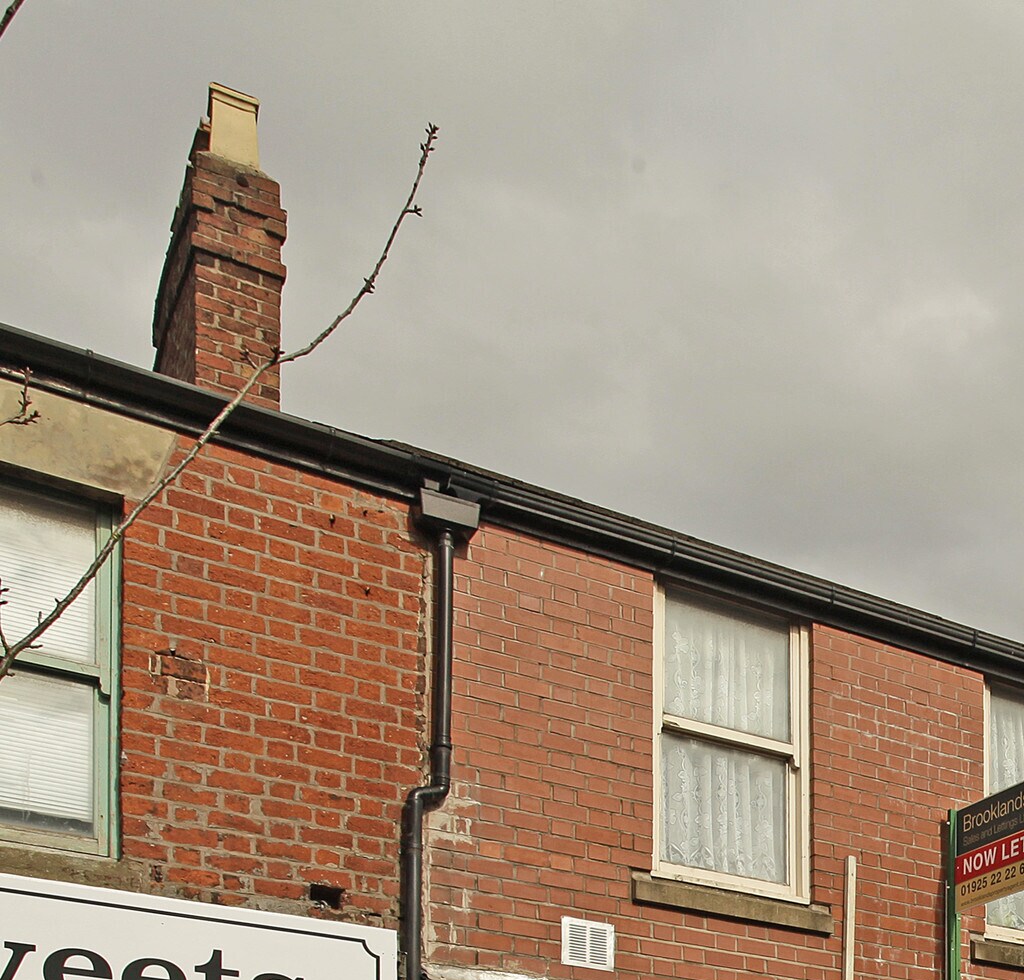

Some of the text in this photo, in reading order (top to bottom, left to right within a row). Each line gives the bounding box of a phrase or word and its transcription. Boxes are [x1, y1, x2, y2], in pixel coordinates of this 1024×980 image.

[981, 828, 992, 838] and
[963, 846, 997, 875] NOW
[960, 876, 987, 896] 01925
[990, 871, 1002, 886] 22
[1004, 866, 1016, 880] 22
